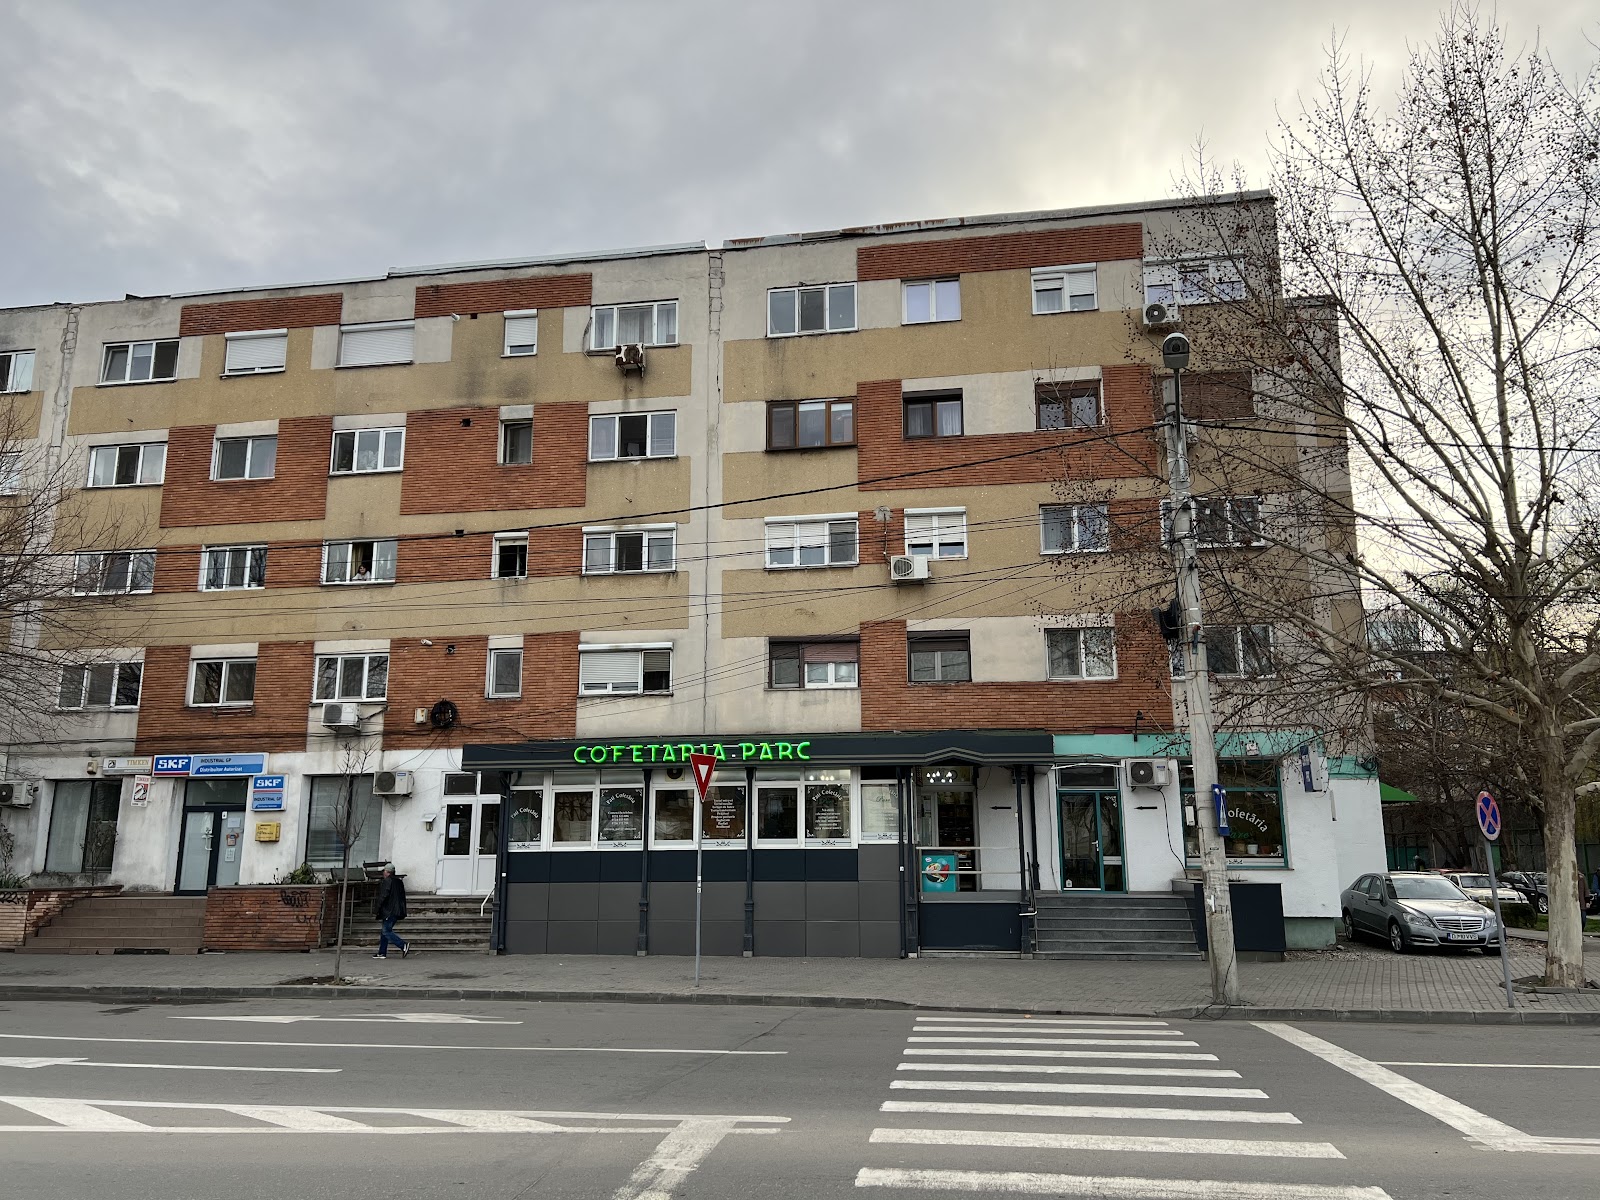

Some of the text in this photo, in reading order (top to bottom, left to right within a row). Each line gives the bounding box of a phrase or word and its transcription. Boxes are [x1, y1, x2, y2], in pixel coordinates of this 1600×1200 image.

[573, 741, 811, 763] COFETARIA PARC
[157, 759, 189, 769] SKF
[256, 778, 282, 787] SKF
[1227, 807, 1268, 833] ofetăria
